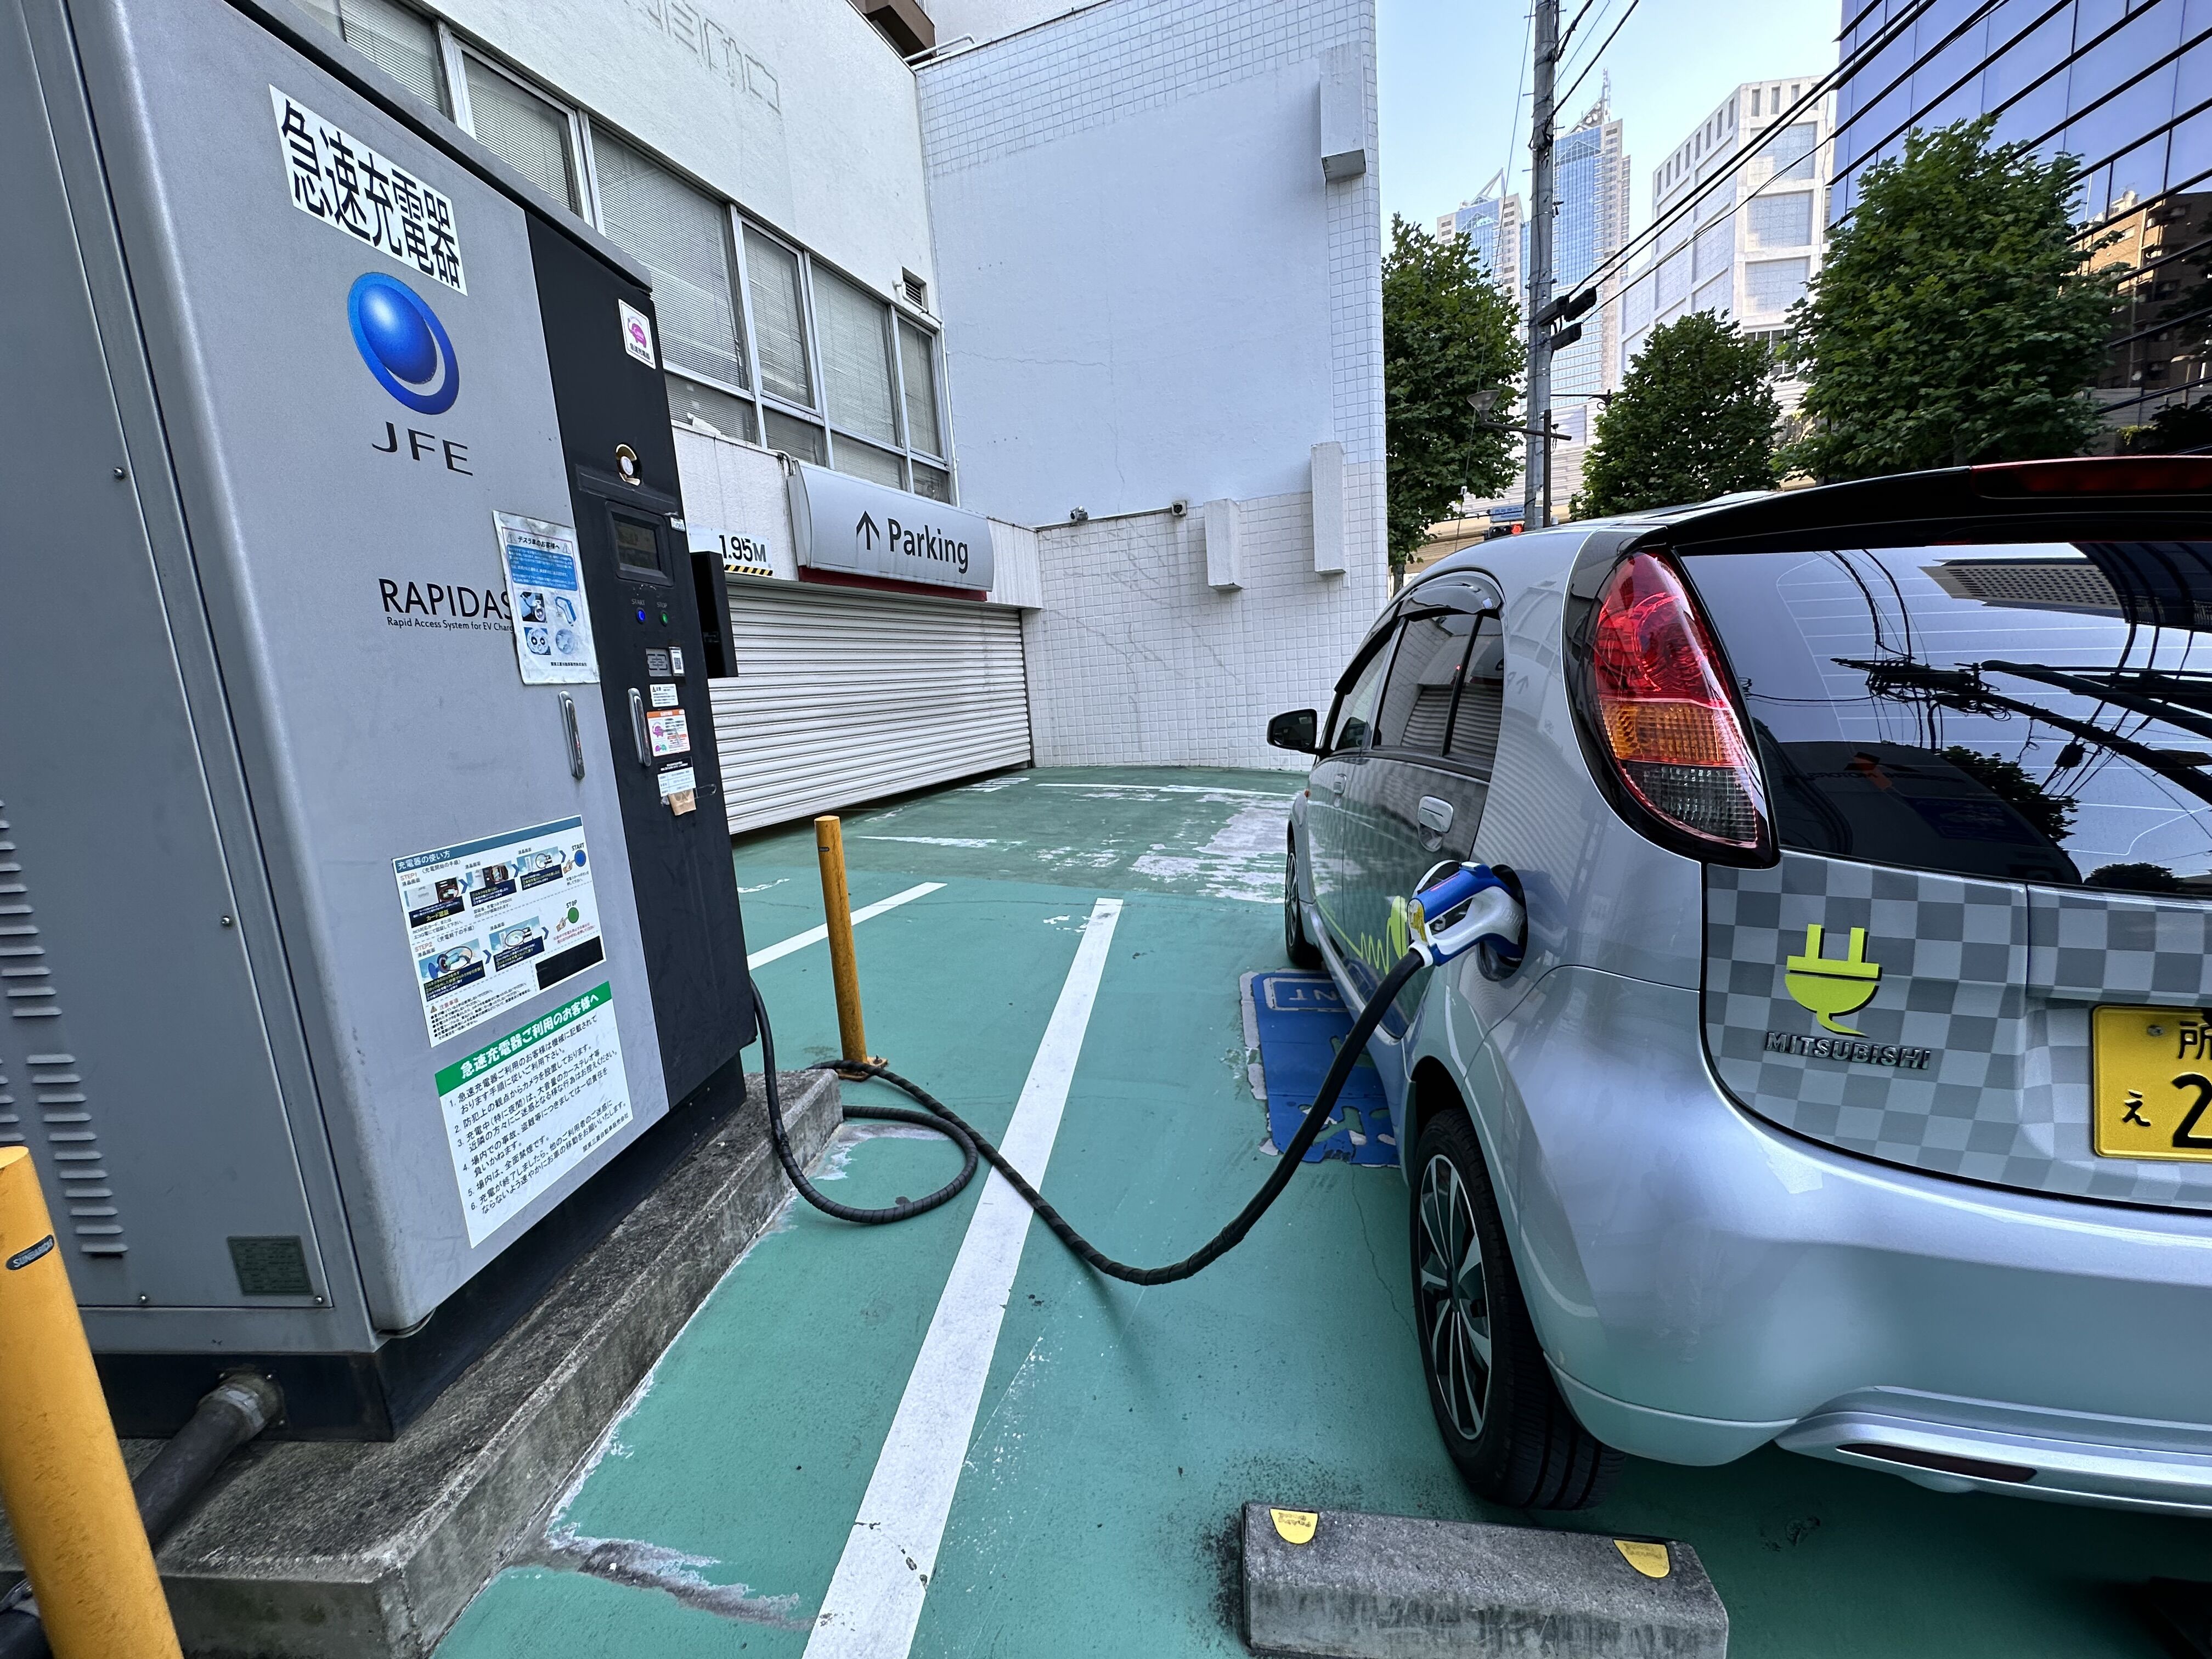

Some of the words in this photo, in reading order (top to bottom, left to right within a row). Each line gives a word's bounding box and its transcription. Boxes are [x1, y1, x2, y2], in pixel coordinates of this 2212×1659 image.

[281, 100, 461, 289] 急速充電器
[372, 422, 473, 476] JFE
[719, 534, 767, 563] 1.95M
[888, 518, 969, 573] Parking
[387, 617, 411, 629] Rapid
[415, 618, 441, 628] Access
[443, 620, 470, 631] System
[471, 621, 482, 630] for
[483, 622, 492, 630] EV
[397, 849, 451, 870] 充電器の使い方
[571, 842, 585, 851] START
[400, 872, 417, 881] STEP1
[566, 899, 577, 909] STOP
[414, 941, 432, 952] STEP2
[457, 1014, 597, 1103] 急速充電器ご利用のお客様は機械に記載されて
[459, 991, 600, 1080] 急速充電器ご利用のお客様へ
[1765, 1032, 1931, 1070] MITSUBISHI
[460, 1044, 565, 1115] おります手順に従いご利用下さい。
[462, 1041, 591, 1129] 防犯上の観点からカメラを設置しております。
[468, 1047, 617, 1153] 近隣の方々にご迷惑となる様な行為はお控えください。
[470, 1066, 608, 1167] 場内での事故、盗難等につきましては一切責任を
[2121, 1090, 2151, 1127] え
[2171, 1072, 2212, 1149] 2
[473, 1137, 522, 1178] 負いかねます。
[476, 1132, 549, 1192] 場内は、全面禁煙です。
[478, 1099, 612, 1205] 充電が終了しましたら、他のご利用者のご迷惑に
[481, 1099, 626, 1216] ならないよう速やかにお車の移動をお願いいたします。
